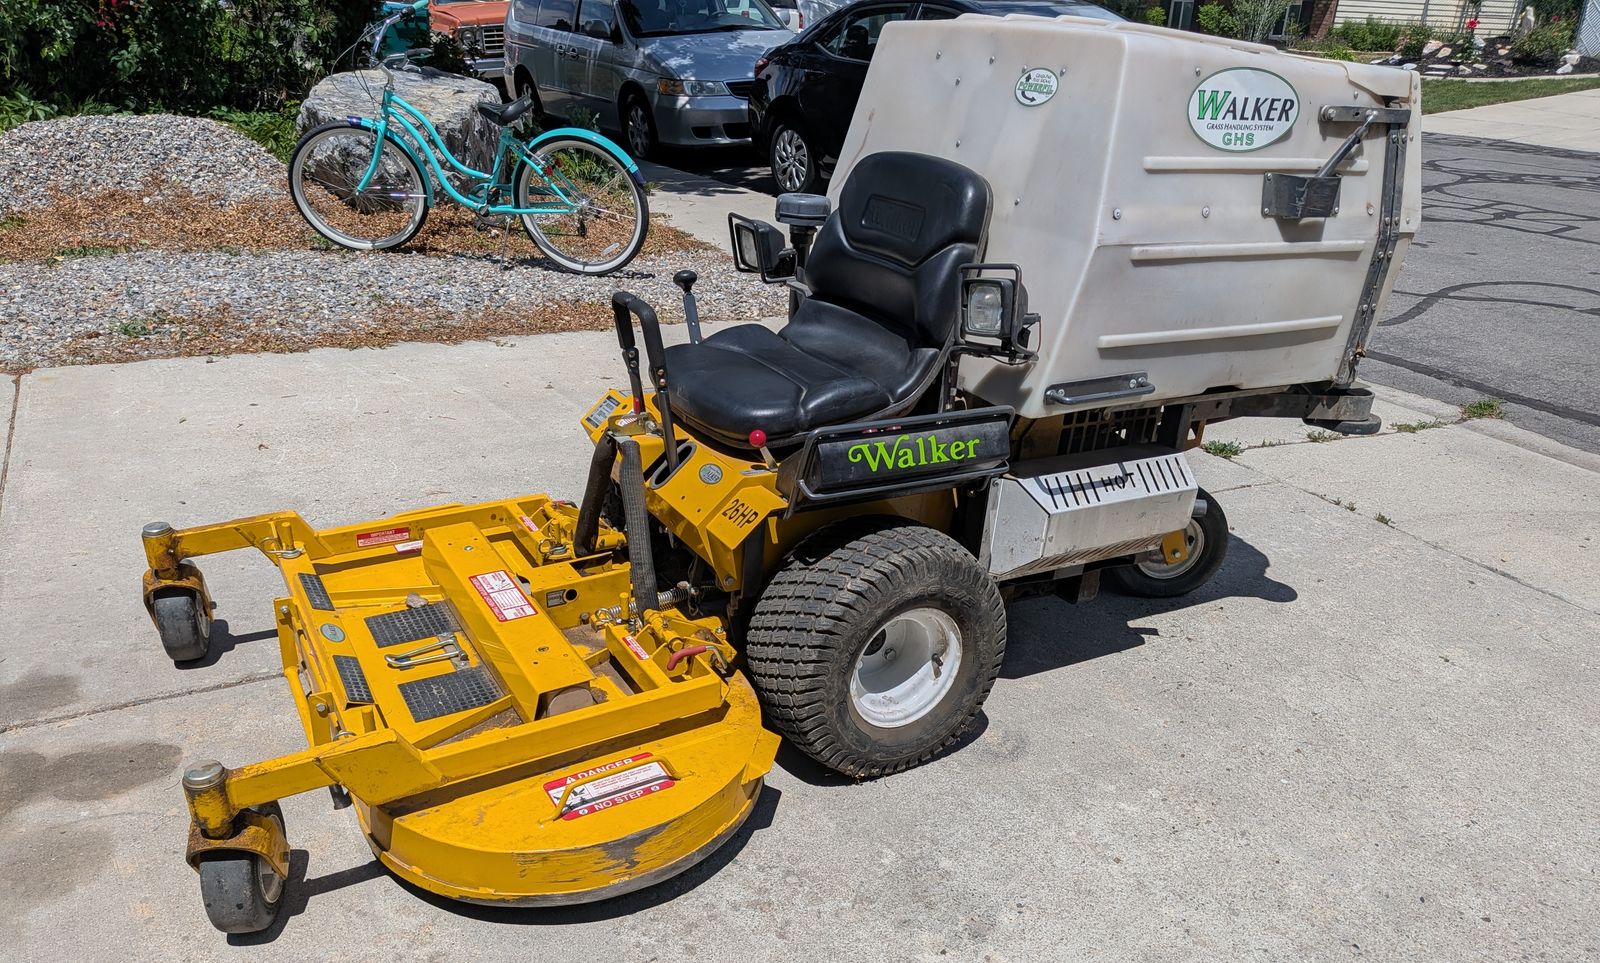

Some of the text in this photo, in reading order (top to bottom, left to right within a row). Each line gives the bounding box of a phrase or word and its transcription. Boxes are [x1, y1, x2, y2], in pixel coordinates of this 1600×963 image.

[1197, 89, 1295, 122] WALKER
[1206, 122, 1274, 131] GRASS HANDLING SYSTEM
[1222, 132, 1255, 146] GHS
[848, 434, 981, 472] Walker
[1101, 472, 1136, 493] HOT
[722, 498, 759, 529] 26HP
[578, 758, 633, 779] DANGER
[593, 790, 644, 811] NO STEP
